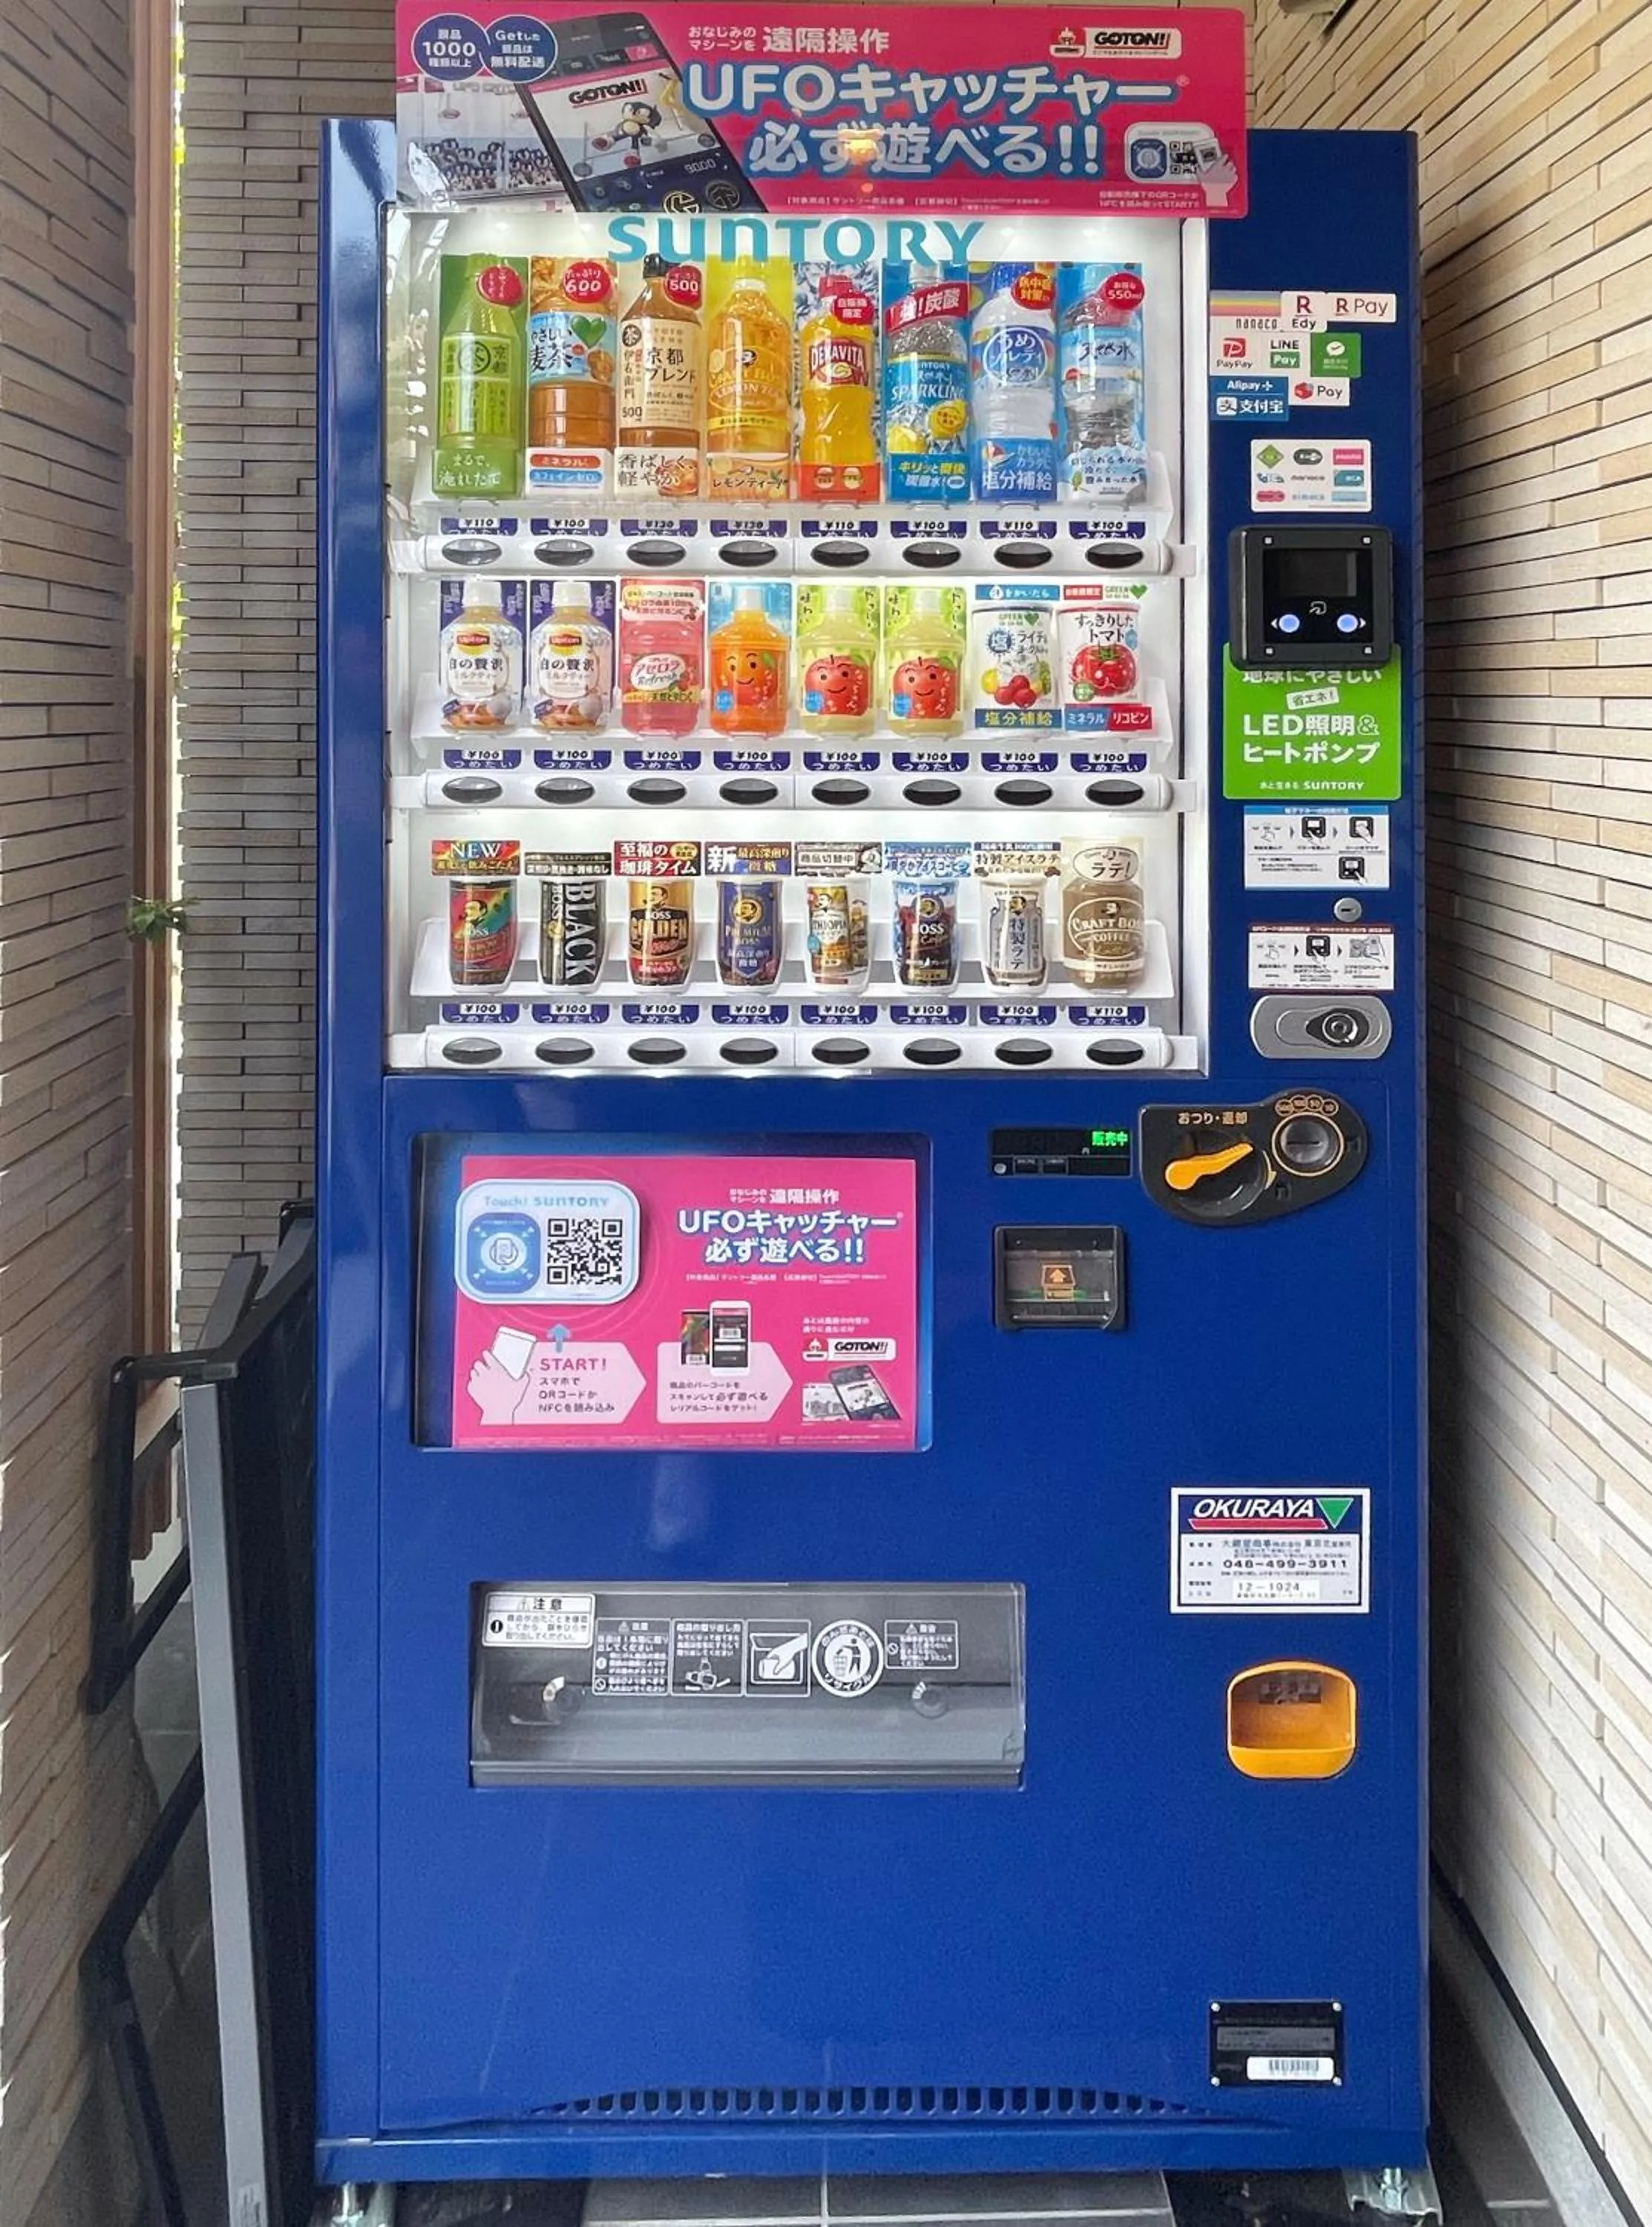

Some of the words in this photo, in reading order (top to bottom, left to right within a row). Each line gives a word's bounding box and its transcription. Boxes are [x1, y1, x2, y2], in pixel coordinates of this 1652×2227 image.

[688, 26, 755, 39] おなじみの
[689, 40, 755, 52] マシーンを
[763, 27, 890, 53] 遠隔操作
[422, 42, 476, 56] 1000
[566, 280, 602, 292] 600
[669, 280, 698, 292] 500
[1354, 298, 1389, 316] Pay
[1236, 318, 1277, 329] nanaco
[1292, 318, 1317, 331] Edy
[1271, 340, 1299, 350] LINE
[530, 343, 573, 372] 麦茶
[647, 348, 684, 364] 京都
[1273, 353, 1297, 367] Pay
[1216, 360, 1253, 369] PayPay
[646, 367, 697, 383] ブレンド
[1317, 385, 1343, 399] Pay
[1239, 399, 1283, 413] 支付宝
[983, 471, 1052, 491] 塩分補給
[1075, 613, 1134, 628] すっきりした
[1089, 630, 1125, 643] トマト
[985, 712, 1052, 727] 塩分補給
[1068, 712, 1105, 725] ミネラル
[1112, 712, 1150, 725] リコピン
[1244, 713, 1380, 736] LED照明&
[468, 750, 499, 759] ¥100
[556, 750, 589, 759] ¥100
[646, 751, 678, 759] ¥100
[736, 752, 768, 760] ¥100
[826, 753, 857, 761] ¥100
[916, 753, 948, 761] ¥100
[1243, 741, 1381, 765] ヒートポンプ
[453, 761, 513, 769] つめたい
[543, 761, 603, 769] つめたい
[632, 762, 692, 770] つめたい
[812, 762, 871, 771] つめたい
[901, 763, 960, 771] つめたい
[1079, 764, 1138, 772] つめたい
[450, 843, 502, 859] NEW
[620, 843, 667, 858] 至福の
[707, 845, 737, 873] 新
[976, 854, 1061, 865] 特製アイスラテ
[620, 860, 698, 875] 珈琲タイム
[1072, 918, 1115, 932] CRAFT
[566, 884, 596, 980] BLACK
[1010, 918, 1025, 970] 特製ラテ
[465, 1004, 496, 1013] ¥100
[556, 1005, 587, 1013] ¥100
[645, 1005, 677, 1013] ¥100
[824, 1006, 855, 1014] ¥100
[913, 1006, 943, 1014] ¥100
[1002, 1006, 1034, 1014] ¥100
[1093, 1007, 1123, 1016] ¥110
[450, 1015, 510, 1023] つめたい
[541, 1015, 600, 1023] つめたい
[809, 1016, 869, 1024] つめたい
[899, 1016, 958, 1024] つめたい
[1092, 1131, 1128, 1146] 販売中
[769, 1188, 840, 1205] 遠隔操作
[705, 1238, 864, 1263] 必ず遊べる!!
[540, 1358, 607, 1372] START!
[539, 1377, 580, 1387] スマホで
[539, 1389, 598, 1400] QRコードか
[539, 1402, 615, 1413] NFCを読み込み
[1193, 1498, 1314, 1518] OKURAYA
[1223, 1559, 1348, 1569] 048-499-3911
[1239, 1583, 1300, 1592] 12-1024
[533, 1598, 563, 1611] 注意
[823, 1672, 873, 1691] リサイクル
